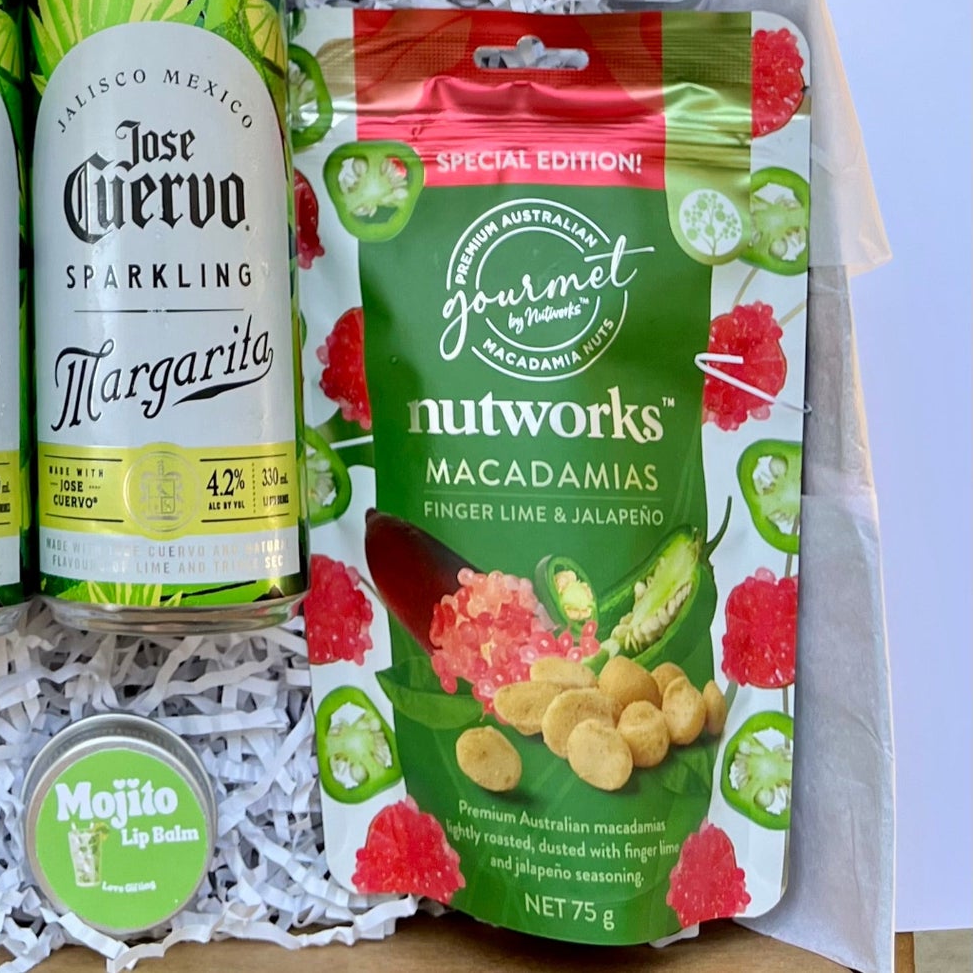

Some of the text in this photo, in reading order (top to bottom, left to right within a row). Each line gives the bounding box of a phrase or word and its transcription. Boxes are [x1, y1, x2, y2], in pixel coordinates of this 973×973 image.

[57, 69, 253, 133] JALISCO MEXICO
[115, 119, 196, 172] Jose
[436, 150, 642, 174] SPECIAL EDITION!
[63, 151, 246, 245] Cuervo
[454, 209, 597, 286] PREMIUM AUSTRALIAN
[66, 263, 252, 289] SPARKLING
[439, 234, 655, 361] gourmet
[507, 311, 525, 335] by
[482, 317, 615, 371] MACADAMIA NUTS
[50, 314, 274, 432] Margarita
[60, 480, 84, 492] JOSE
[76, 465, 104, 478] WITH
[206, 468, 245, 497] 4.2%
[262, 467, 278, 486] 330
[425, 457, 659, 491] MACADAMIAS
[208, 502, 221, 510] ALC
[424, 501, 664, 527] FINGER LIME & JALAPEÑO
[136, 555, 284, 574] LIME AND SEC
[148, 545, 205, 557] CUERVO
[55, 778, 178, 829] Mojito
[458, 799, 666, 835] Premium Australian macadamias
[121, 825, 199, 850] Lip Balm
[484, 831, 536, 854] roasted,
[538, 842, 586, 857] dusted
[590, 842, 621, 859] with
[624, 842, 657, 863] finger
[659, 839, 680, 856] lime
[490, 854, 645, 888] and jalapeño seasoning.
[524, 892, 615, 931] NET 75 g
